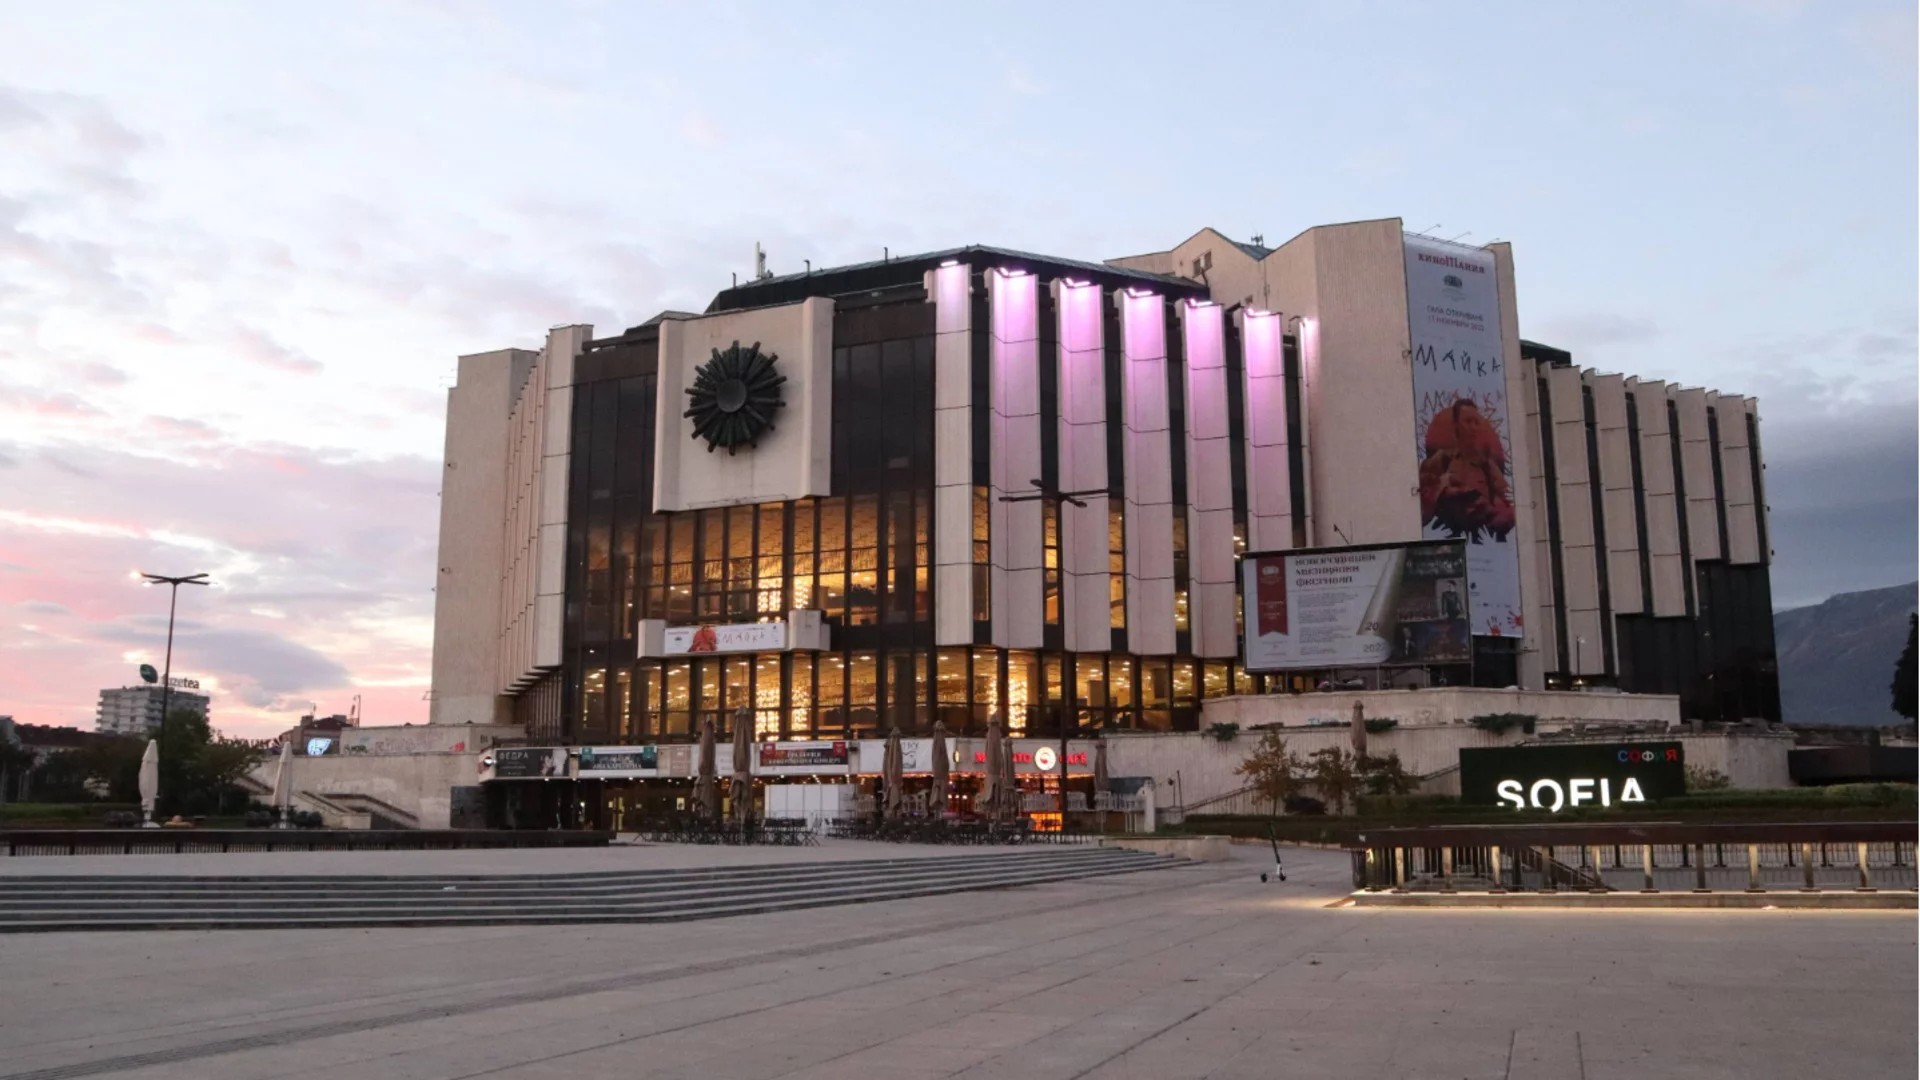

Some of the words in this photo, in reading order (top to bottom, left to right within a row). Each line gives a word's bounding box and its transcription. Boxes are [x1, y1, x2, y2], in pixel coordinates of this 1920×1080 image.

[1415, 343, 1501, 377] МАЙКА
[1617, 749, 1677, 762] СОФИЯ
[1496, 777, 1646, 813] SOFIA
